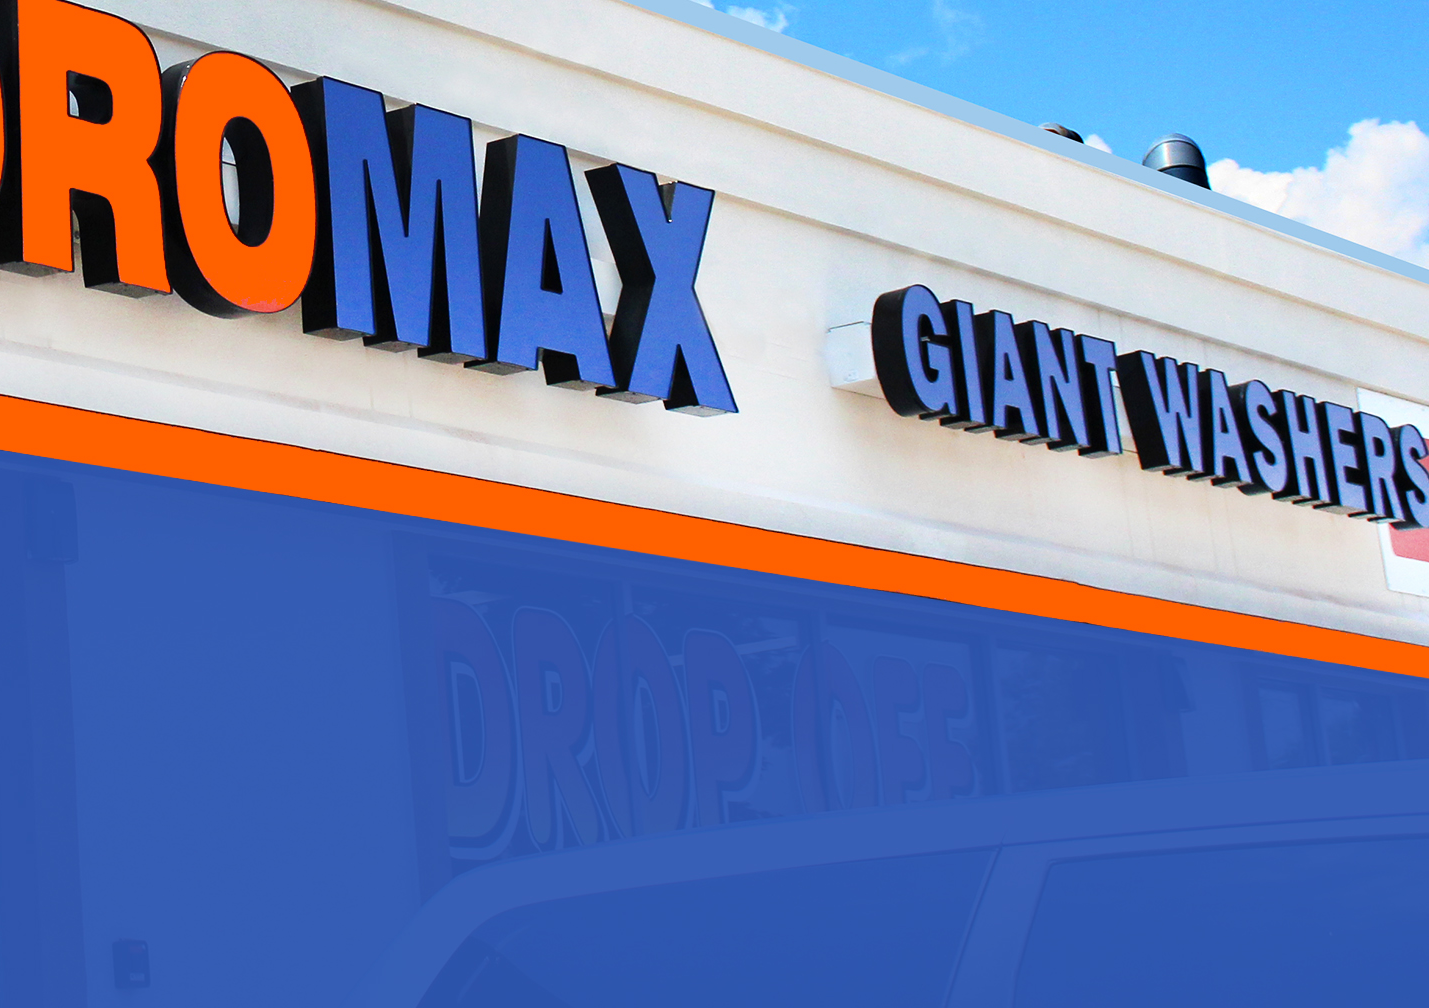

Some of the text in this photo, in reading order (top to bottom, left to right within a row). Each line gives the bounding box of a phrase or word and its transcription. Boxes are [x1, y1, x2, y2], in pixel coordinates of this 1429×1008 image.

[873, 283, 1429, 530] GIANT WASHERS
[428, 594, 763, 860] DROP
